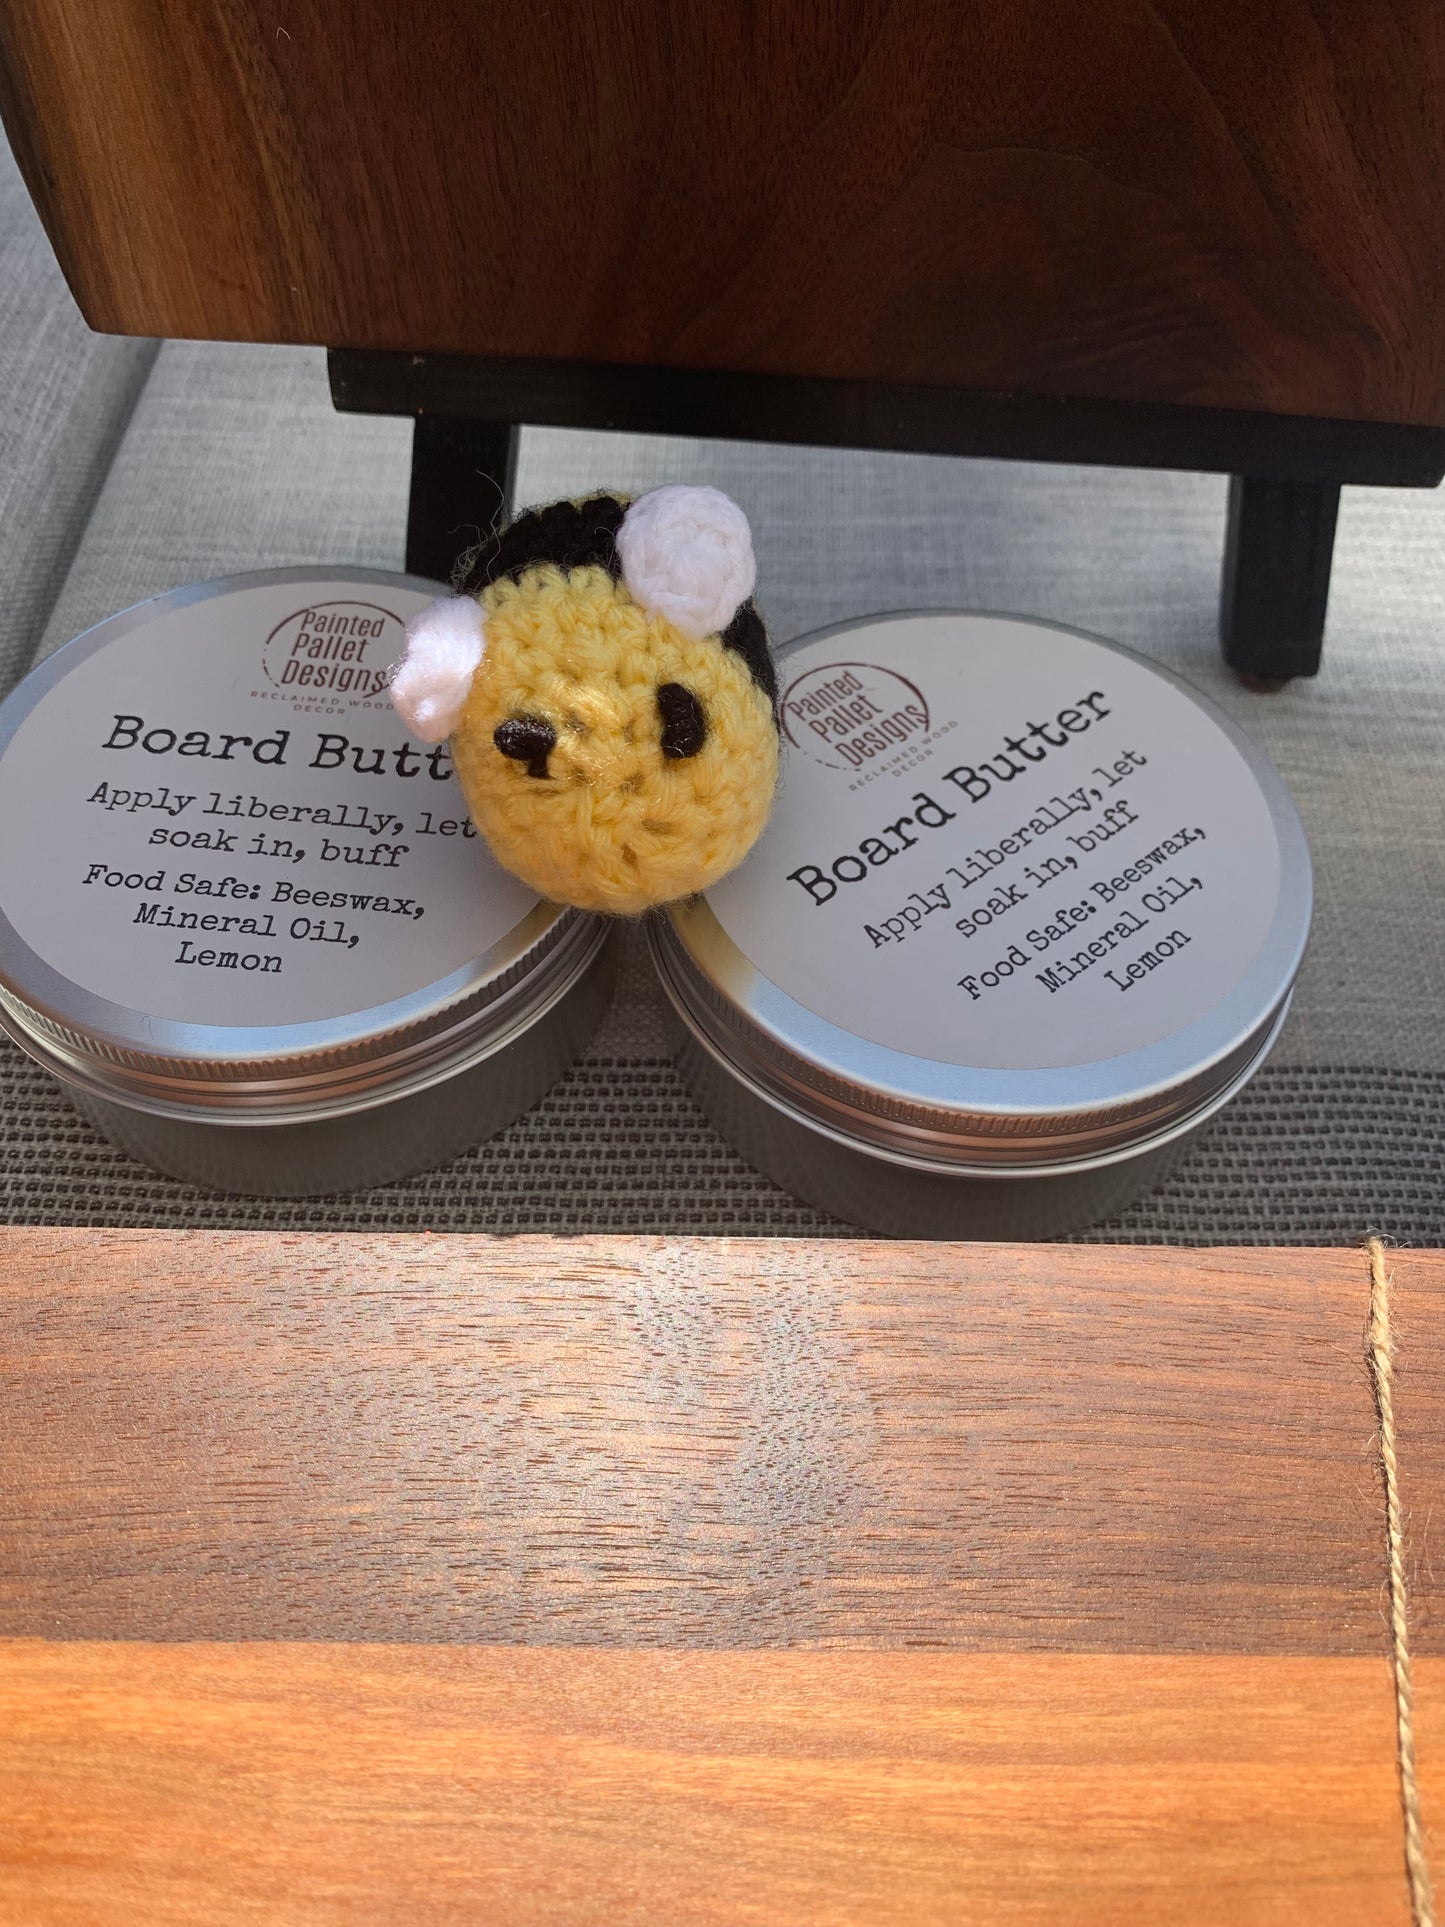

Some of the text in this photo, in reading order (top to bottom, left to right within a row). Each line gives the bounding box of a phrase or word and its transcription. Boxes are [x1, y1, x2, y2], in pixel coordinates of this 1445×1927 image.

[291, 633, 369, 663] Pallet
[301, 611, 385, 638] Painted
[250, 691, 394, 711] RECLAIMED WOOD
[281, 660, 387, 692] Designs
[787, 670, 863, 722] Painted
[293, 704, 346, 715] DECOR
[809, 694, 884, 743] Pallet
[835, 705, 928, 766] Designs
[102, 715, 453, 780] Board Butt
[848, 721, 958, 791] RECLAIMED WOOD
[892, 749, 934, 777] DECOR
[87, 782, 478, 838] Apply liberally, let
[786, 690, 1111, 906] Board Butter
[149, 827, 409, 867] soak in, buff
[863, 748, 1147, 949] Apply liberally, let
[955, 800, 1139, 938] soak in, buff
[82, 864, 425, 920] Food Safe: Beeswax,
[957, 827, 1207, 1000] Food Safe: Beeswax,
[133, 902, 360, 949] Mineral Oil,
[1035, 877, 1203, 993] Mineral Oil,
[175, 941, 283, 973] Lemon
[1103, 929, 1191, 992] Lemon
